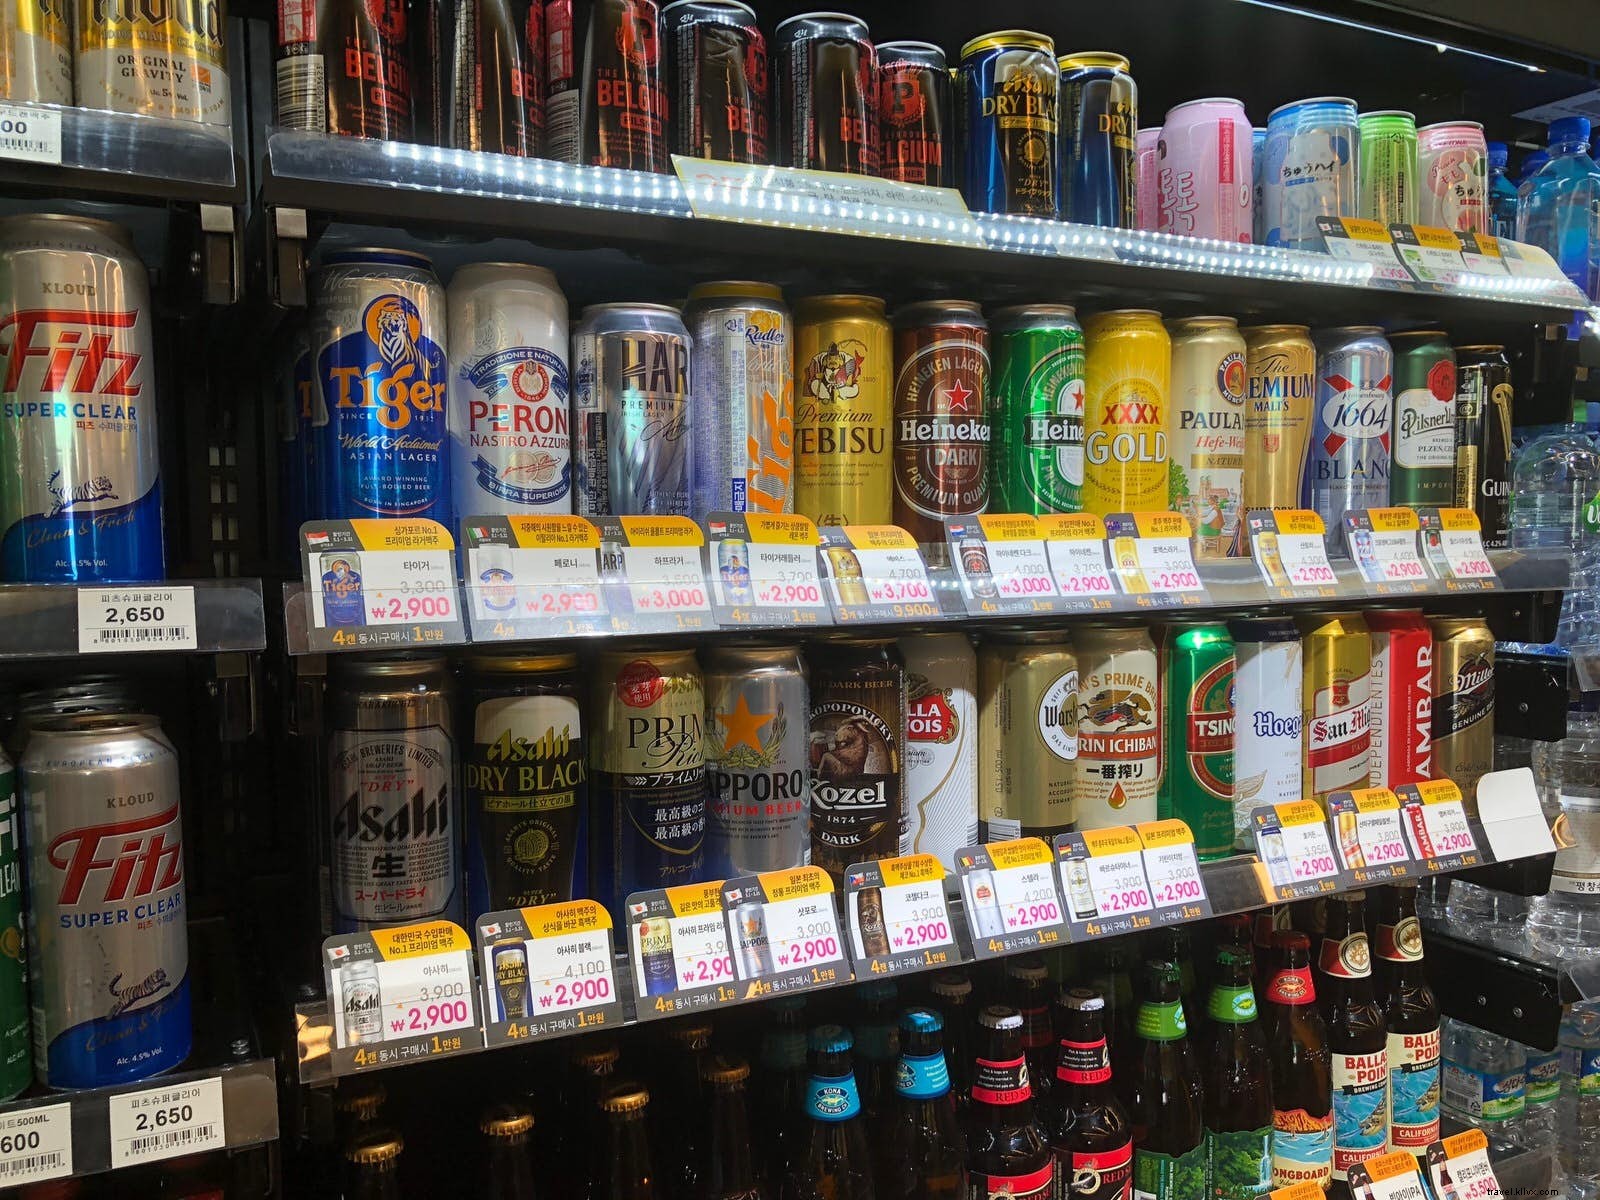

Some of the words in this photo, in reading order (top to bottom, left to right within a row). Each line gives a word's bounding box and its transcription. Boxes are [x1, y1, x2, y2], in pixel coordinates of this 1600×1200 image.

[117, 54, 187, 72] ORIGINAL
[121, 67, 184, 84] GRAVITY
[982, 95, 1020, 117] DRY
[1282, 160, 1336, 177] ちゅうハイ
[41, 282, 97, 297] KLOUD
[745, 324, 785, 342] Radler
[0, 308, 144, 396] Fitz
[1255, 353, 1296, 374] The
[330, 361, 446, 429] Tiger
[5, 403, 67, 418] SUPER
[73, 403, 137, 420] CLEAR
[621, 401, 674, 411] PREMIUM
[797, 404, 873, 423] Premium
[1102, 404, 1160, 425] XXXX
[1333, 400, 1388, 428] 1664
[340, 413, 372, 421] SINCE
[1180, 410, 1245, 430] PAULA
[1401, 407, 1444, 438] Pilsner
[470, 434, 527, 448] NASTRO
[1086, 431, 1167, 465] GOLD
[350, 452, 392, 461] ASIAN
[401, 453, 437, 462] LAGER
[935, 449, 977, 465] DARK
[907, 466, 959, 506] PREMIUM
[394, 526, 421, 536] 싱가포르
[422, 525, 438, 535] No.1
[385, 536, 412, 546] 프리미엄
[412, 535, 439, 545] 라거맥주
[403, 560, 430, 571] 타이거
[554, 558, 578, 568] 페로니
[654, 556, 683, 566] 하프라거
[400, 580, 446, 594] 3,300
[106, 607, 165, 624] 2,650
[332, 629, 356, 645] 4캔
[358, 633, 379, 645] 동시
[380, 631, 410, 643] 구매시
[413, 626, 444, 641] 1만원
[865, 680, 893, 689] BEER
[1104, 673, 1145, 687] PRIME
[1415, 645, 1432, 778] AMBAR
[1452, 711, 1480, 730] GENUINE
[1312, 719, 1347, 743] San
[487, 724, 569, 761] Asahi
[1110, 738, 1156, 753] ICHIBAN
[359, 745, 404, 758] BREWERIES
[408, 749, 433, 769] LIMITED
[466, 764, 510, 791] DRY
[519, 760, 586, 791] BLACK
[1086, 763, 1143, 779] 一番搾り
[107, 792, 154, 808] KLOUD
[811, 779, 886, 810] Kozel
[332, 783, 448, 842] Asahi
[765, 802, 803, 815] BEER
[827, 815, 855, 824] 1874
[821, 832, 861, 845] DARK
[47, 800, 183, 905] Fitz
[371, 852, 406, 878] 生
[789, 875, 801, 884] 일본
[1168, 867, 1195, 881] 3,900
[785, 884, 809, 895] 프리미엄
[1116, 876, 1142, 890] 3,900
[355, 886, 427, 900] スーパードライ
[905, 891, 929, 902] 코젤다크
[1024, 888, 1053, 903] 4,200
[60, 910, 129, 929] SUPER
[134, 892, 182, 919] CLEAR
[556, 908, 578, 919] 아사히
[578, 904, 597, 916] 맥주의
[679, 902, 691, 913] 깊은
[692, 901, 704, 911] 맛의
[797, 905, 817, 917] 삿포로
[912, 906, 944, 922] 3,900
[543, 921, 563, 933] 상식을
[563, 918, 577, 930] 바꾼
[578, 916, 598, 927] 흑맥주
[678, 926, 697, 937] 아사히
[697, 923, 716, 934] 프라임
[797, 921, 831, 939] 3,900
[392, 931, 422, 944] 대한민국
[423, 926, 453, 939] 수입판매
[389, 945, 407, 955] No.1
[409, 941, 438, 952] 프리미엄
[439, 937, 455, 948] 맥주
[556, 943, 577, 956] 아사히
[578, 941, 592, 952] 블랙
[423, 963, 449, 976] 아사히
[564, 959, 605, 979] 4,100
[419, 982, 464, 1001] 3,900
[507, 1022, 529, 1039] 4캔
[530, 1021, 547, 1036] 동시
[548, 1016, 576, 1031] 구매시
[577, 1011, 605, 1028] 1만원
[354, 1048, 378, 1066] 4캔
[379, 1047, 399, 1062] 동시
[400, 1042, 430, 1058] 구매시
[431, 1036, 461, 1053] 1만원
[817, 1103, 842, 1114] BREWING
[136, 1105, 193, 1131] 2,650
